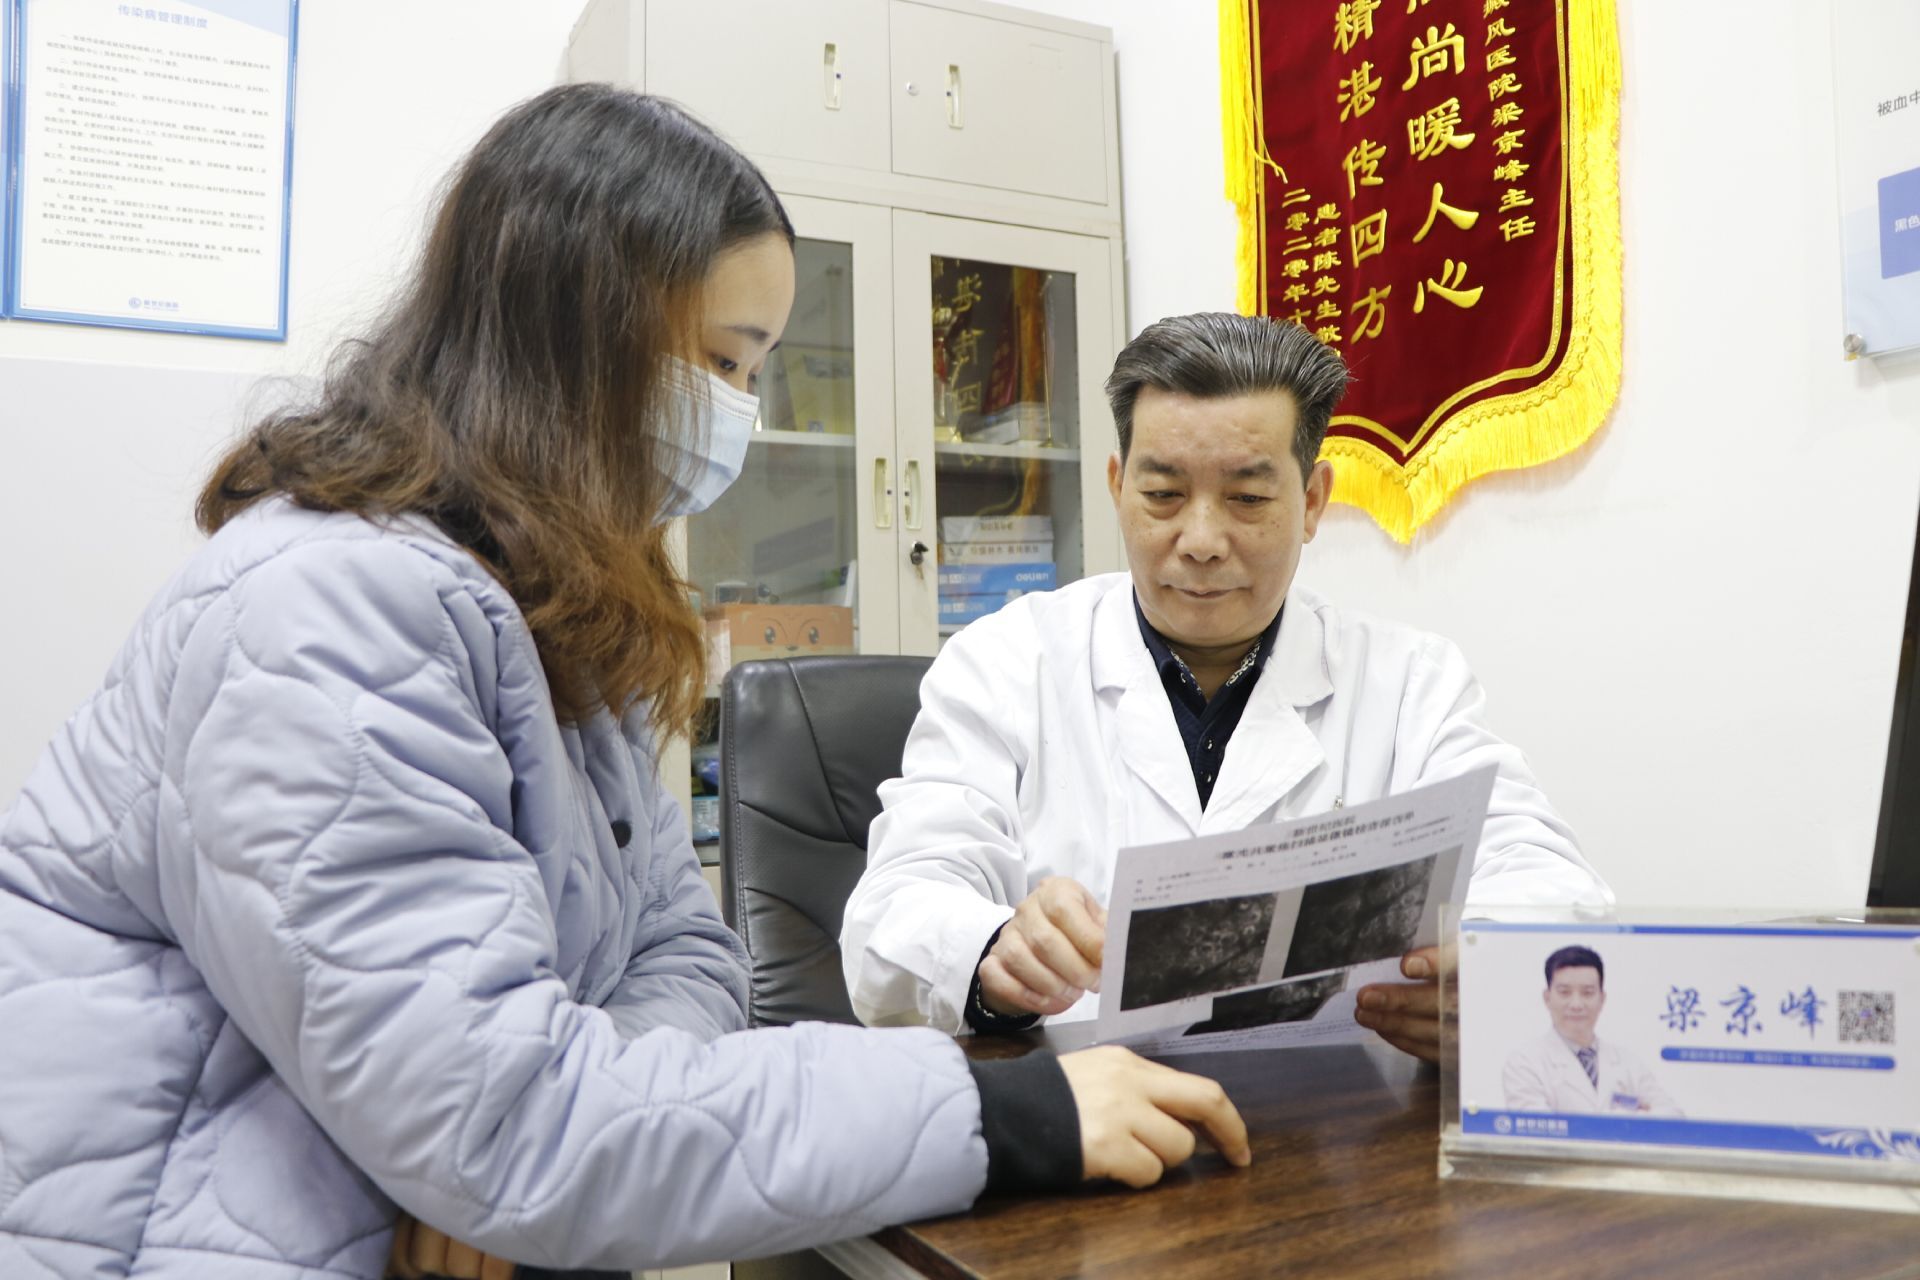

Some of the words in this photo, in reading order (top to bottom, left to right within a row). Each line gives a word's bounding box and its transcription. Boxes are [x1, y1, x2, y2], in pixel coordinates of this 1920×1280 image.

[1333, 0, 1392, 344] 精湛传四方
[1402, 0, 1484, 314] 尚暖人心
[1659, 984, 1827, 1040] 梁京峰
